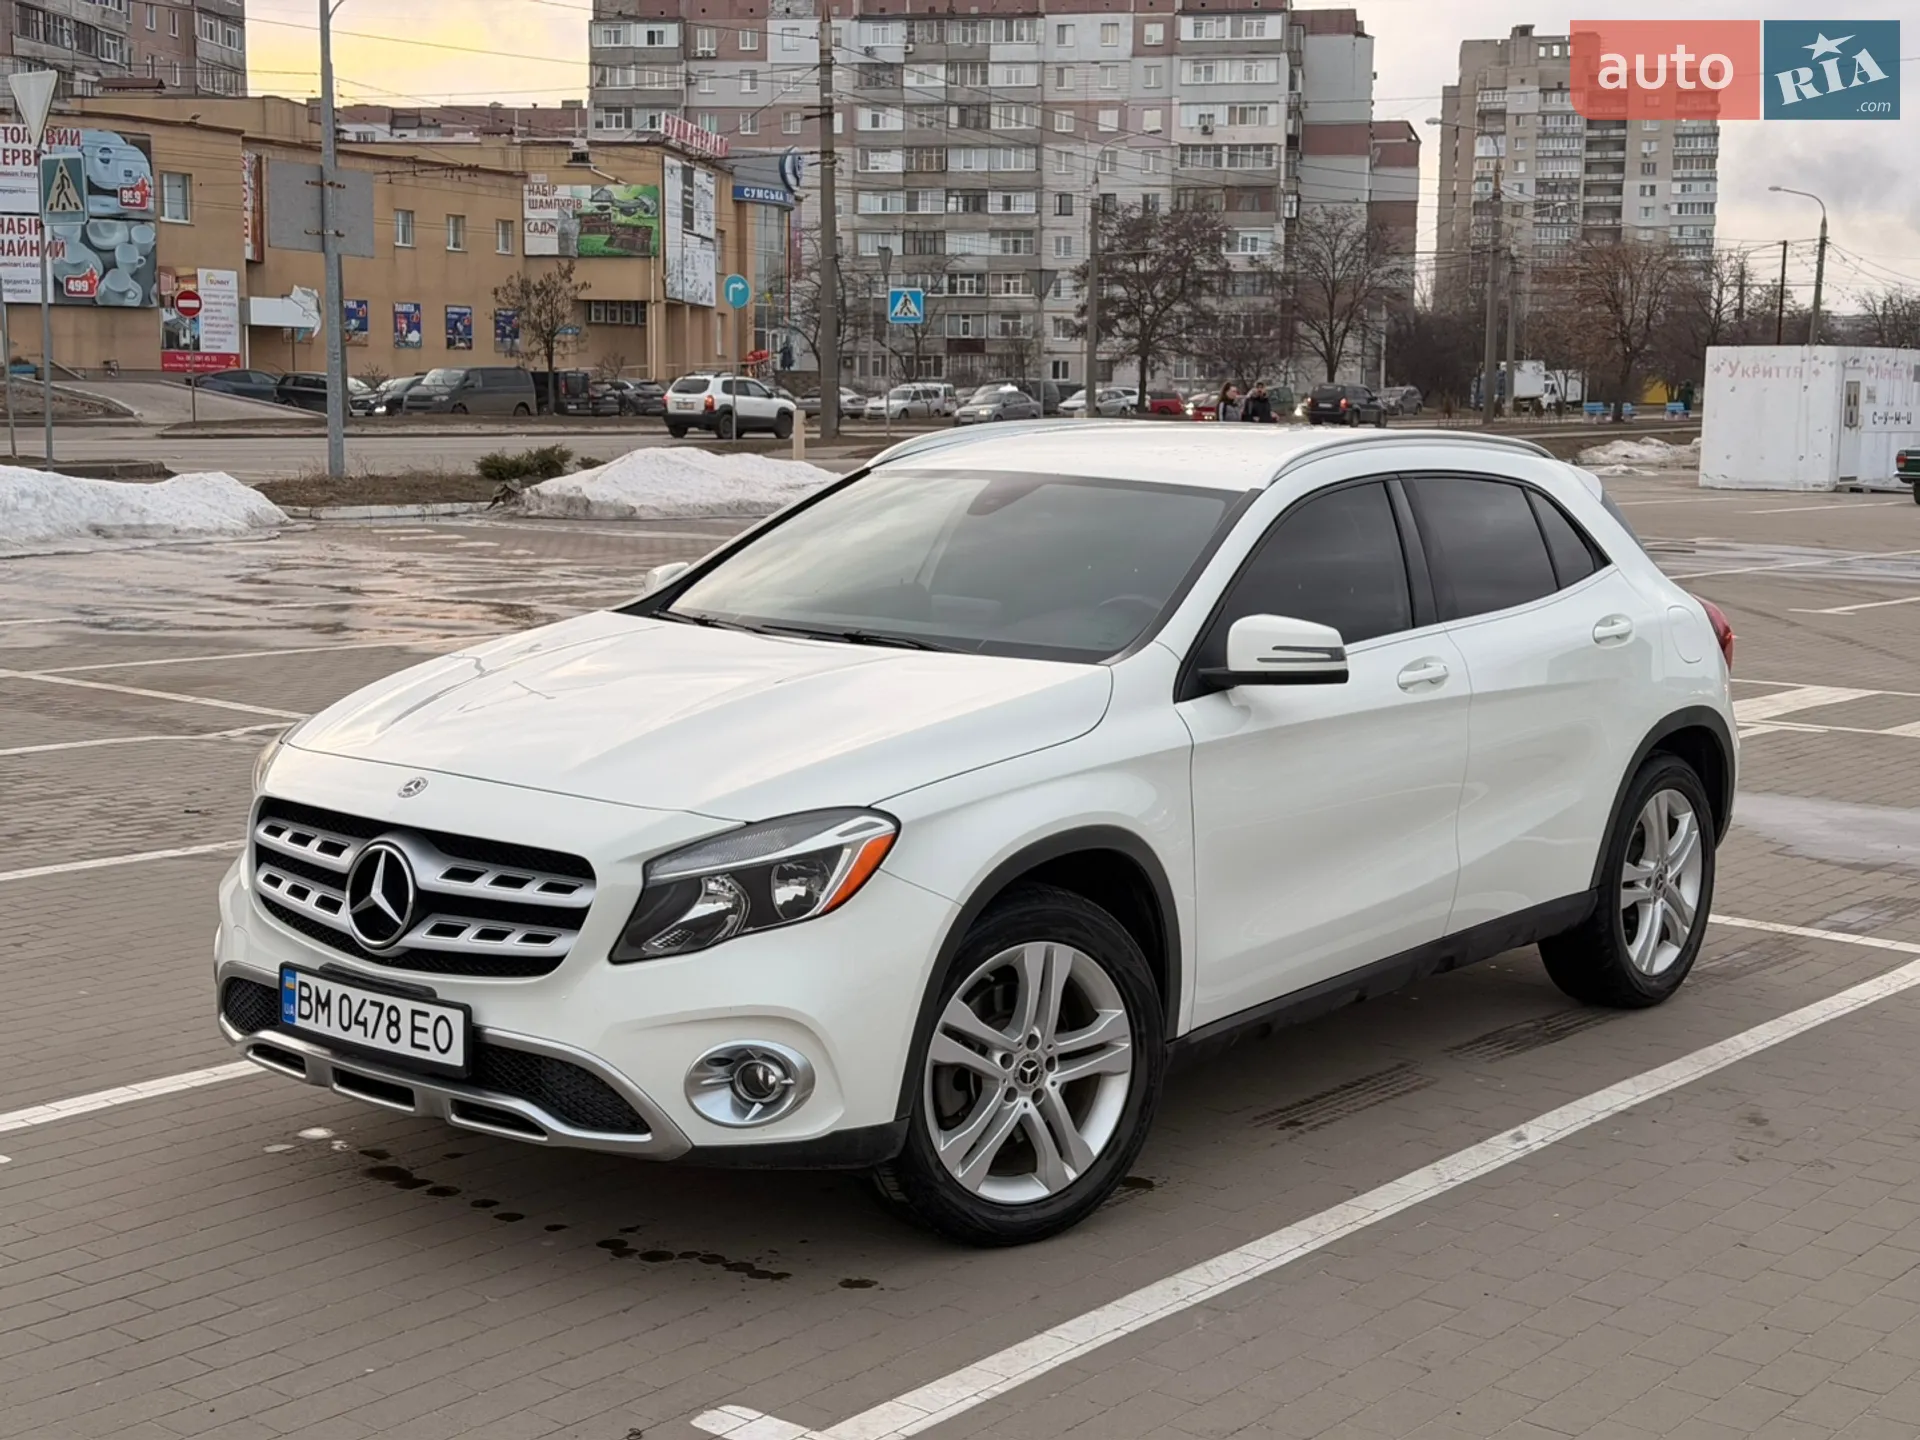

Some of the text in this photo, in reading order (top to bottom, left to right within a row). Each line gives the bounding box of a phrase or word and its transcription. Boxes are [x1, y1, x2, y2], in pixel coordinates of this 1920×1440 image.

[528, 184, 558, 196] НАБІР
[743, 187, 784, 201] СУМСЬКА
[528, 198, 583, 210] ШАМПУРІВ
[68, 279, 89, 292] 499
[298, 980, 453, 1055] BM 0478 EO
